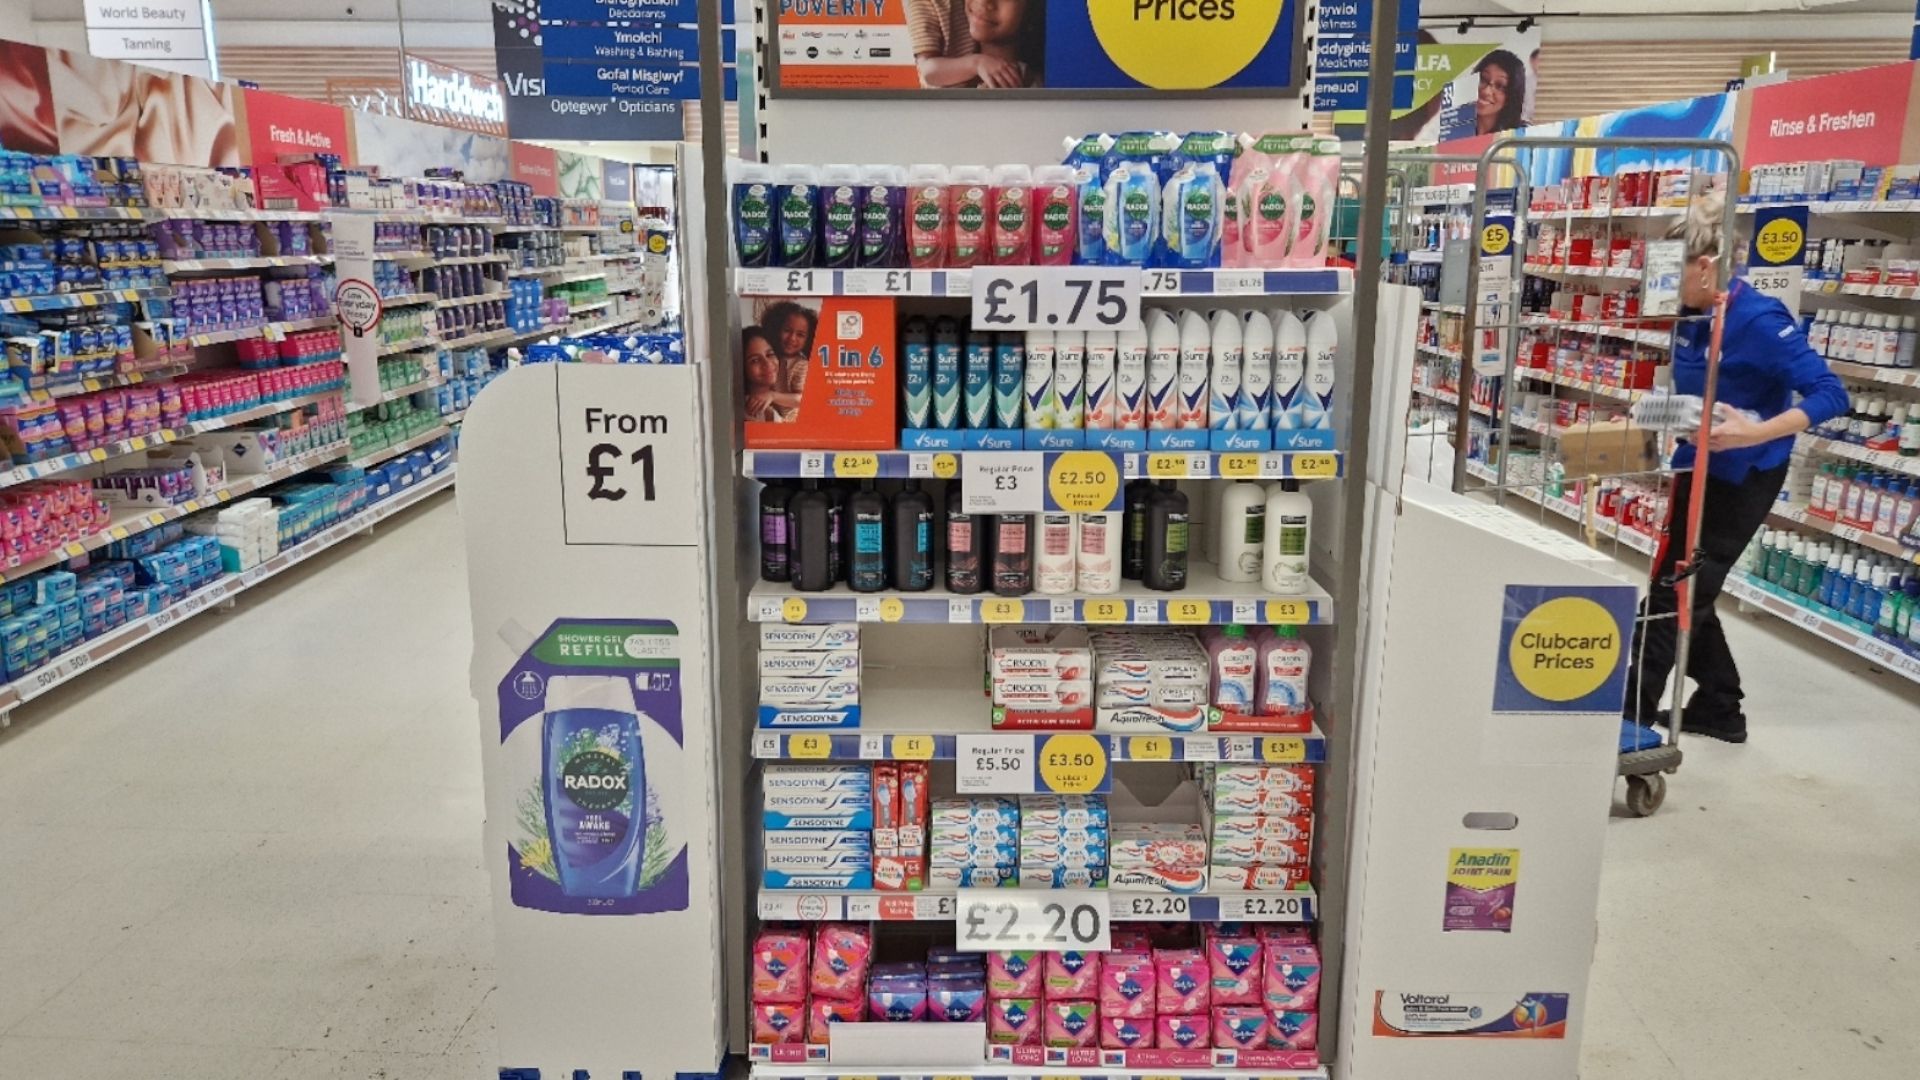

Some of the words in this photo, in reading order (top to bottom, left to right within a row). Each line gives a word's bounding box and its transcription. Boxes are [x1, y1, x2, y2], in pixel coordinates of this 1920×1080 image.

[100, 5, 138, 19] World
[142, 5, 186, 21] Beauty
[780, 0, 884, 15] POVERTY
[1134, 0, 1235, 20] Prices
[609, 8, 666, 19] Deodorants
[614, 32, 662, 43] Ymolchi
[122, 37, 171, 53] Tanning
[594, 46, 636, 58] Washing
[647, 46, 684, 59] Bathing
[1416, 54, 1451, 71] LFA
[597, 68, 629, 80] Gofal
[632, 68, 684, 83] Misglwyf
[612, 83, 643, 94] Period
[646, 84, 670, 95] Care
[1315, 80, 1358, 93] eneuol
[551, 99, 607, 114] Optegwyr
[619, 100, 675, 115] Opticians
[1769, 119, 1803, 137] Rinse
[1807, 114, 1816, 132] &
[1819, 110, 1875, 132] Freshen
[270, 124, 297, 144] Fresh
[297, 128, 305, 146] &
[305, 130, 331, 149] Active
[1487, 229, 1504, 241] £5
[1762, 232, 1798, 244] £3.50
[787, 270, 814, 292] £1
[886, 271, 912, 292] £1
[1753, 278, 1789, 290] £5.50
[984, 278, 1127, 325] £1.75
[818, 344, 830, 368] 1
[838, 344, 861, 368] in
[868, 344, 884, 368] 6
[938, 353, 957, 363] Sure
[969, 353, 989, 363] Sure
[1060, 352, 1079, 361] Sure
[1123, 352, 1144, 361] Sure
[1183, 352, 1204, 361] Sure
[1278, 352, 1298, 361] Sure
[924, 437, 948, 448] Sure
[987, 437, 1011, 448] Sure
[1049, 436, 1074, 448] Sure
[1110, 437, 1134, 448] Sure
[1171, 437, 1195, 448] Sure
[1235, 437, 1260, 448] Sure
[1298, 437, 1323, 447] Sure
[807, 459, 821, 468] £3
[1193, 459, 1206, 469] £3
[1265, 459, 1278, 469] £3
[995, 475, 1018, 490] £3
[1059, 472, 1106, 485] £2.50
[995, 604, 1010, 614] £3
[1098, 604, 1113, 615] £3
[1182, 604, 1197, 615] £3
[1280, 604, 1295, 615] £3
[558, 634, 601, 643] SHOWER
[603, 635, 621, 643] GEL
[765, 632, 816, 641] SENSODYNE
[1520, 632, 1612, 650] Clubcard
[560, 644, 624, 657] REFILL
[763, 658, 816, 668] SENSODYNE
[1533, 653, 1594, 670] Prices
[765, 685, 817, 693] SENSODYNE
[780, 714, 839, 723] SENSODYNE
[1111, 712, 1164, 725] Aquafresh
[763, 740, 775, 749] £5
[803, 739, 818, 749] £3
[907, 740, 920, 750] £1
[1146, 743, 1157, 751] £1
[976, 757, 1021, 771] £5.50
[1049, 753, 1094, 767] £3.50
[564, 775, 627, 790] RADOX
[769, 779, 827, 787] SENSODYNE
[771, 797, 828, 805] SENSODYNE
[579, 821, 610, 830] AWAKE
[770, 837, 827, 845] SENSODYNE
[1456, 852, 1511, 866] Anadin
[1452, 867, 1483, 876] JOINT
[1485, 867, 1511, 876] PAIN
[1114, 875, 1167, 886] Aquafresh
[1132, 899, 1186, 914] £2.20
[1244, 899, 1299, 915] £2.20
[965, 902, 1100, 944] £2.20
[1400, 992, 1449, 1004] Voltarol
